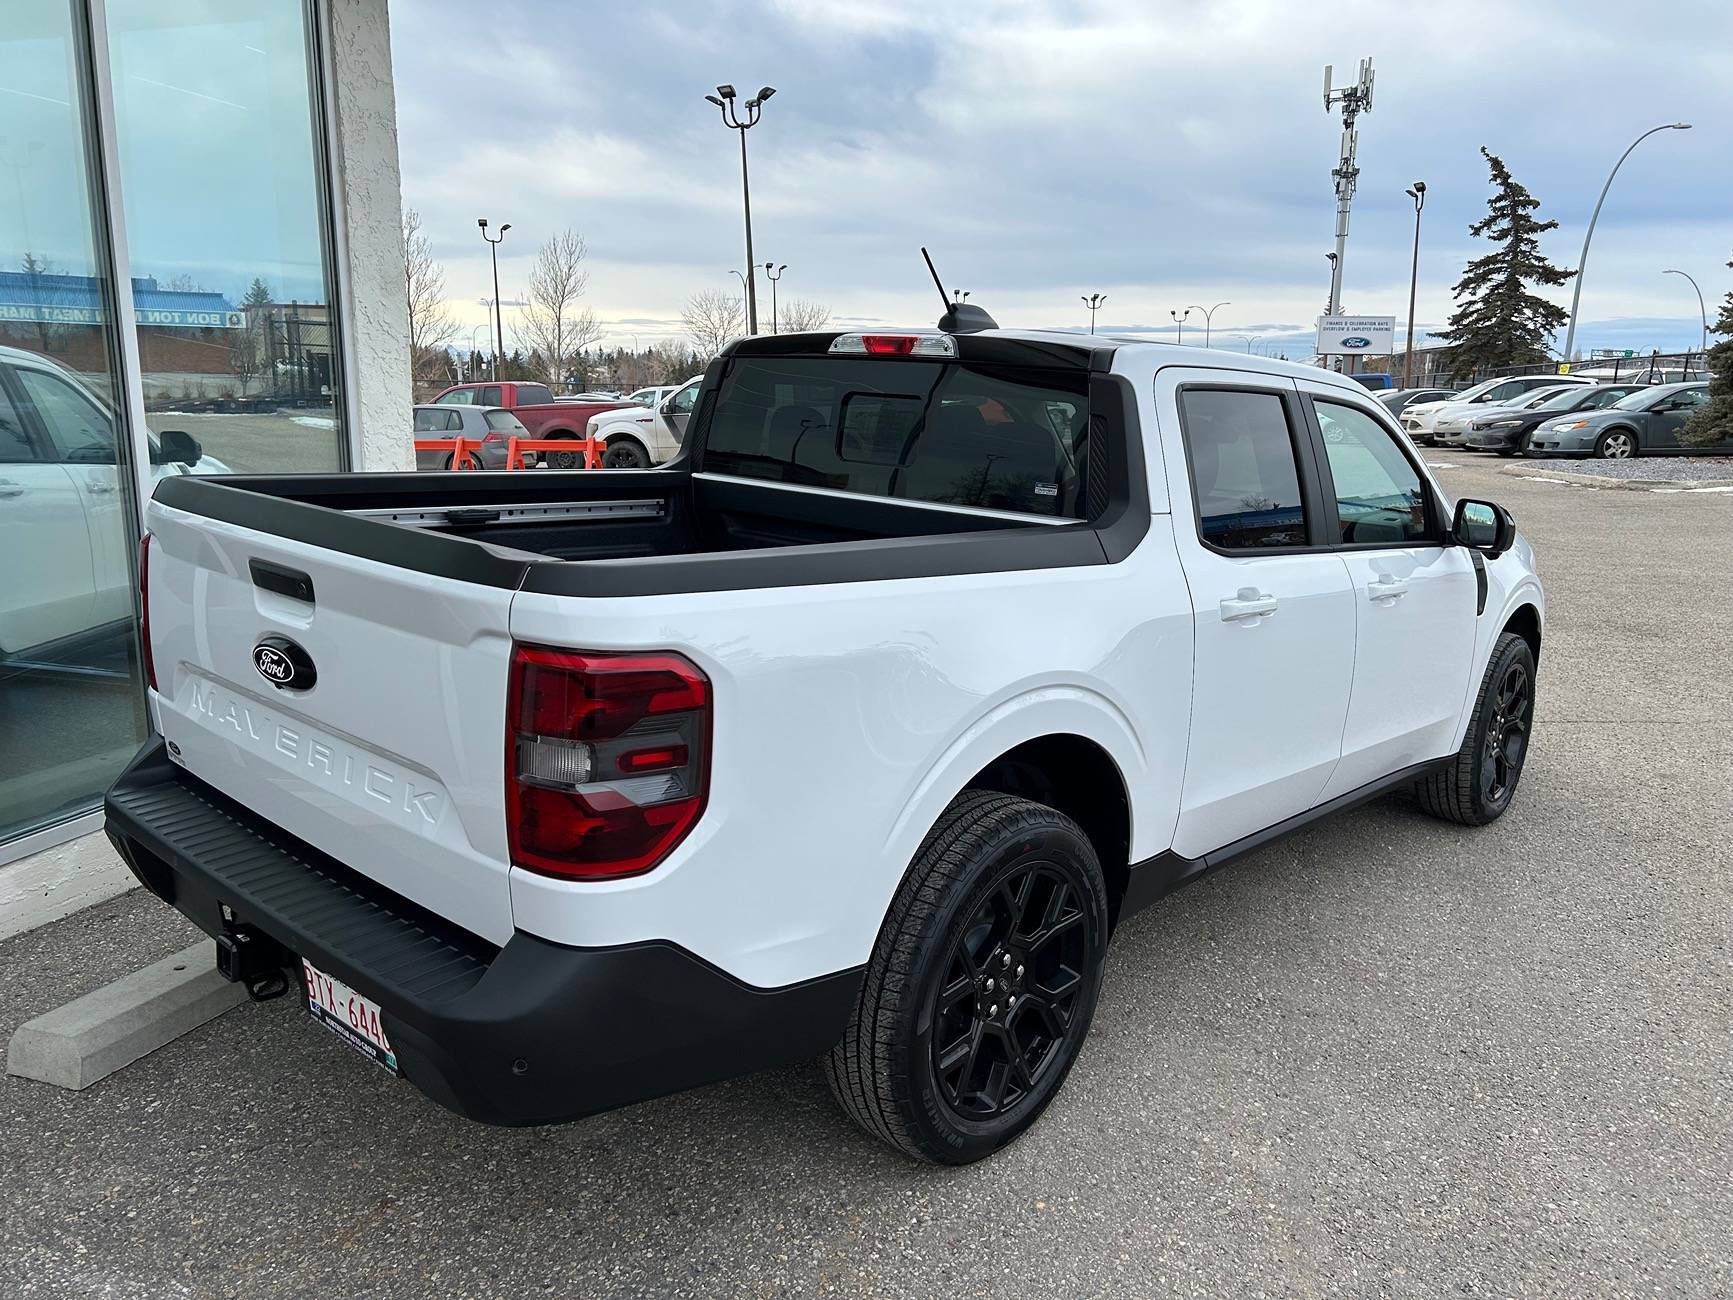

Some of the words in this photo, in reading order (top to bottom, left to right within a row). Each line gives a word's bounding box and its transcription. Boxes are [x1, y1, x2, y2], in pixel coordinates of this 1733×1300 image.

[1346, 337, 1365, 347] Ford
[259, 650, 286, 679] Ford
[191, 681, 439, 824] MAVERICK
